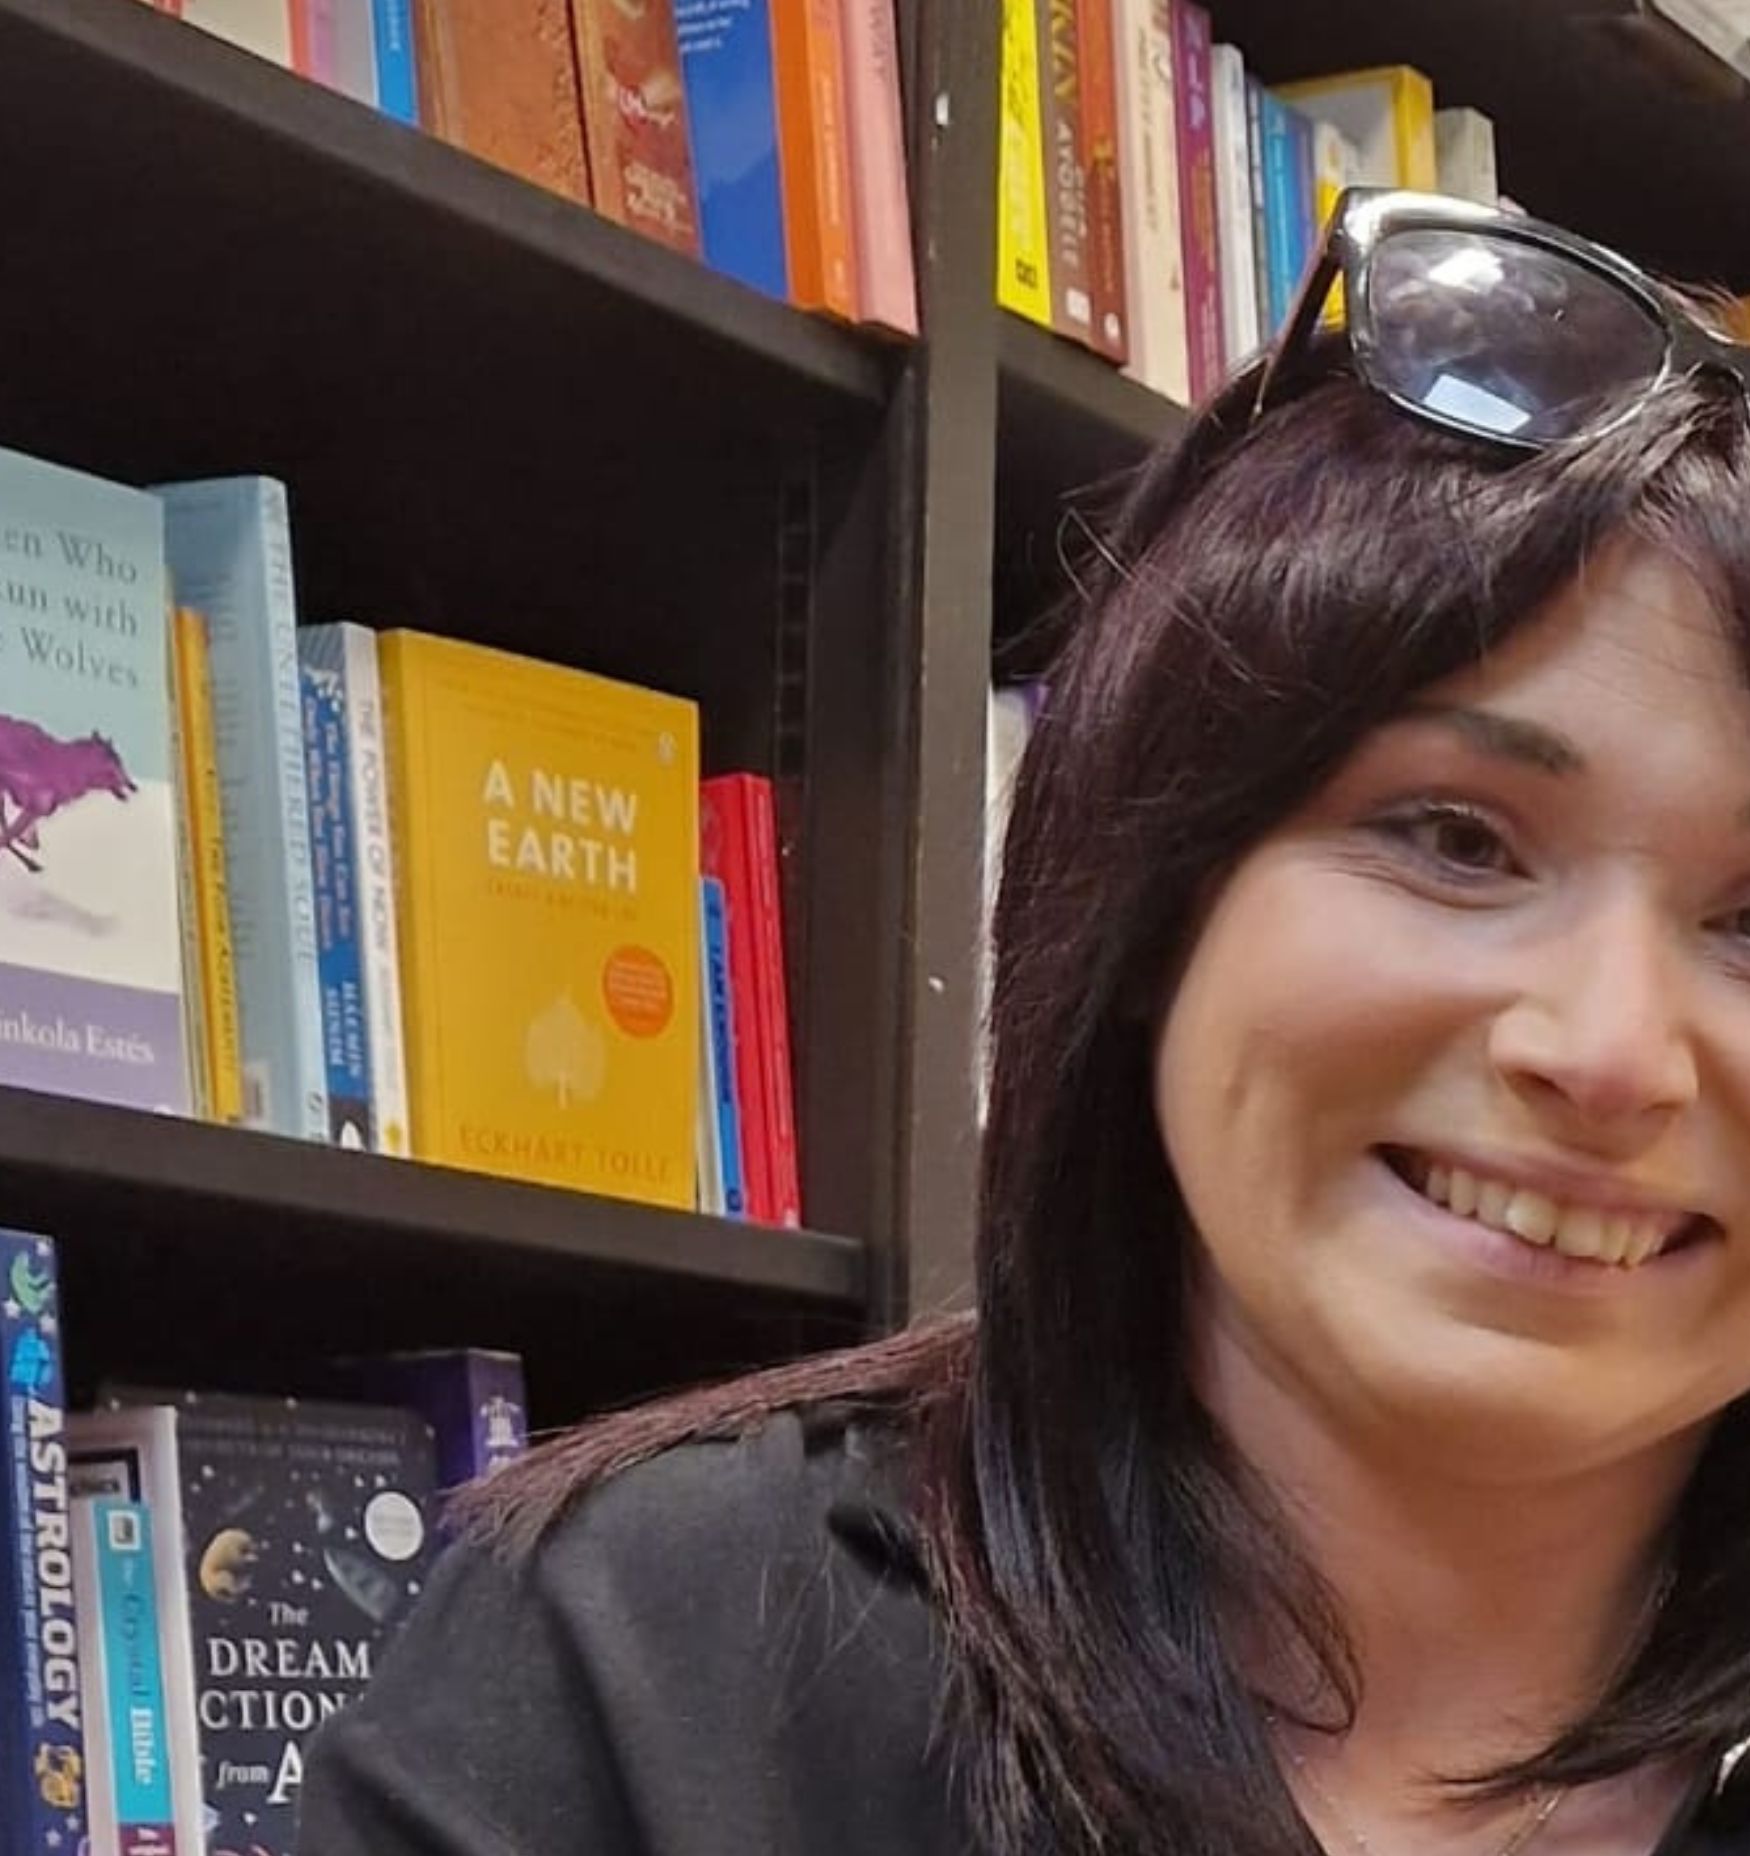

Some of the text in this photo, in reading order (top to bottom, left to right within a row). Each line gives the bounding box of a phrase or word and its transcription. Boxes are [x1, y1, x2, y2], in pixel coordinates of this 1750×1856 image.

[57, 529, 139, 585] Who
[20, 626, 140, 690] Wolves
[482, 760, 640, 840] A NEW
[485, 816, 640, 892] EARTH
[28, 1399, 82, 1729] ASTROLOGY
[270, 1603, 310, 1627] The
[207, 1637, 373, 1680] DREAM
[131, 1704, 157, 1786] Bible
[217, 1760, 268, 1789] from
